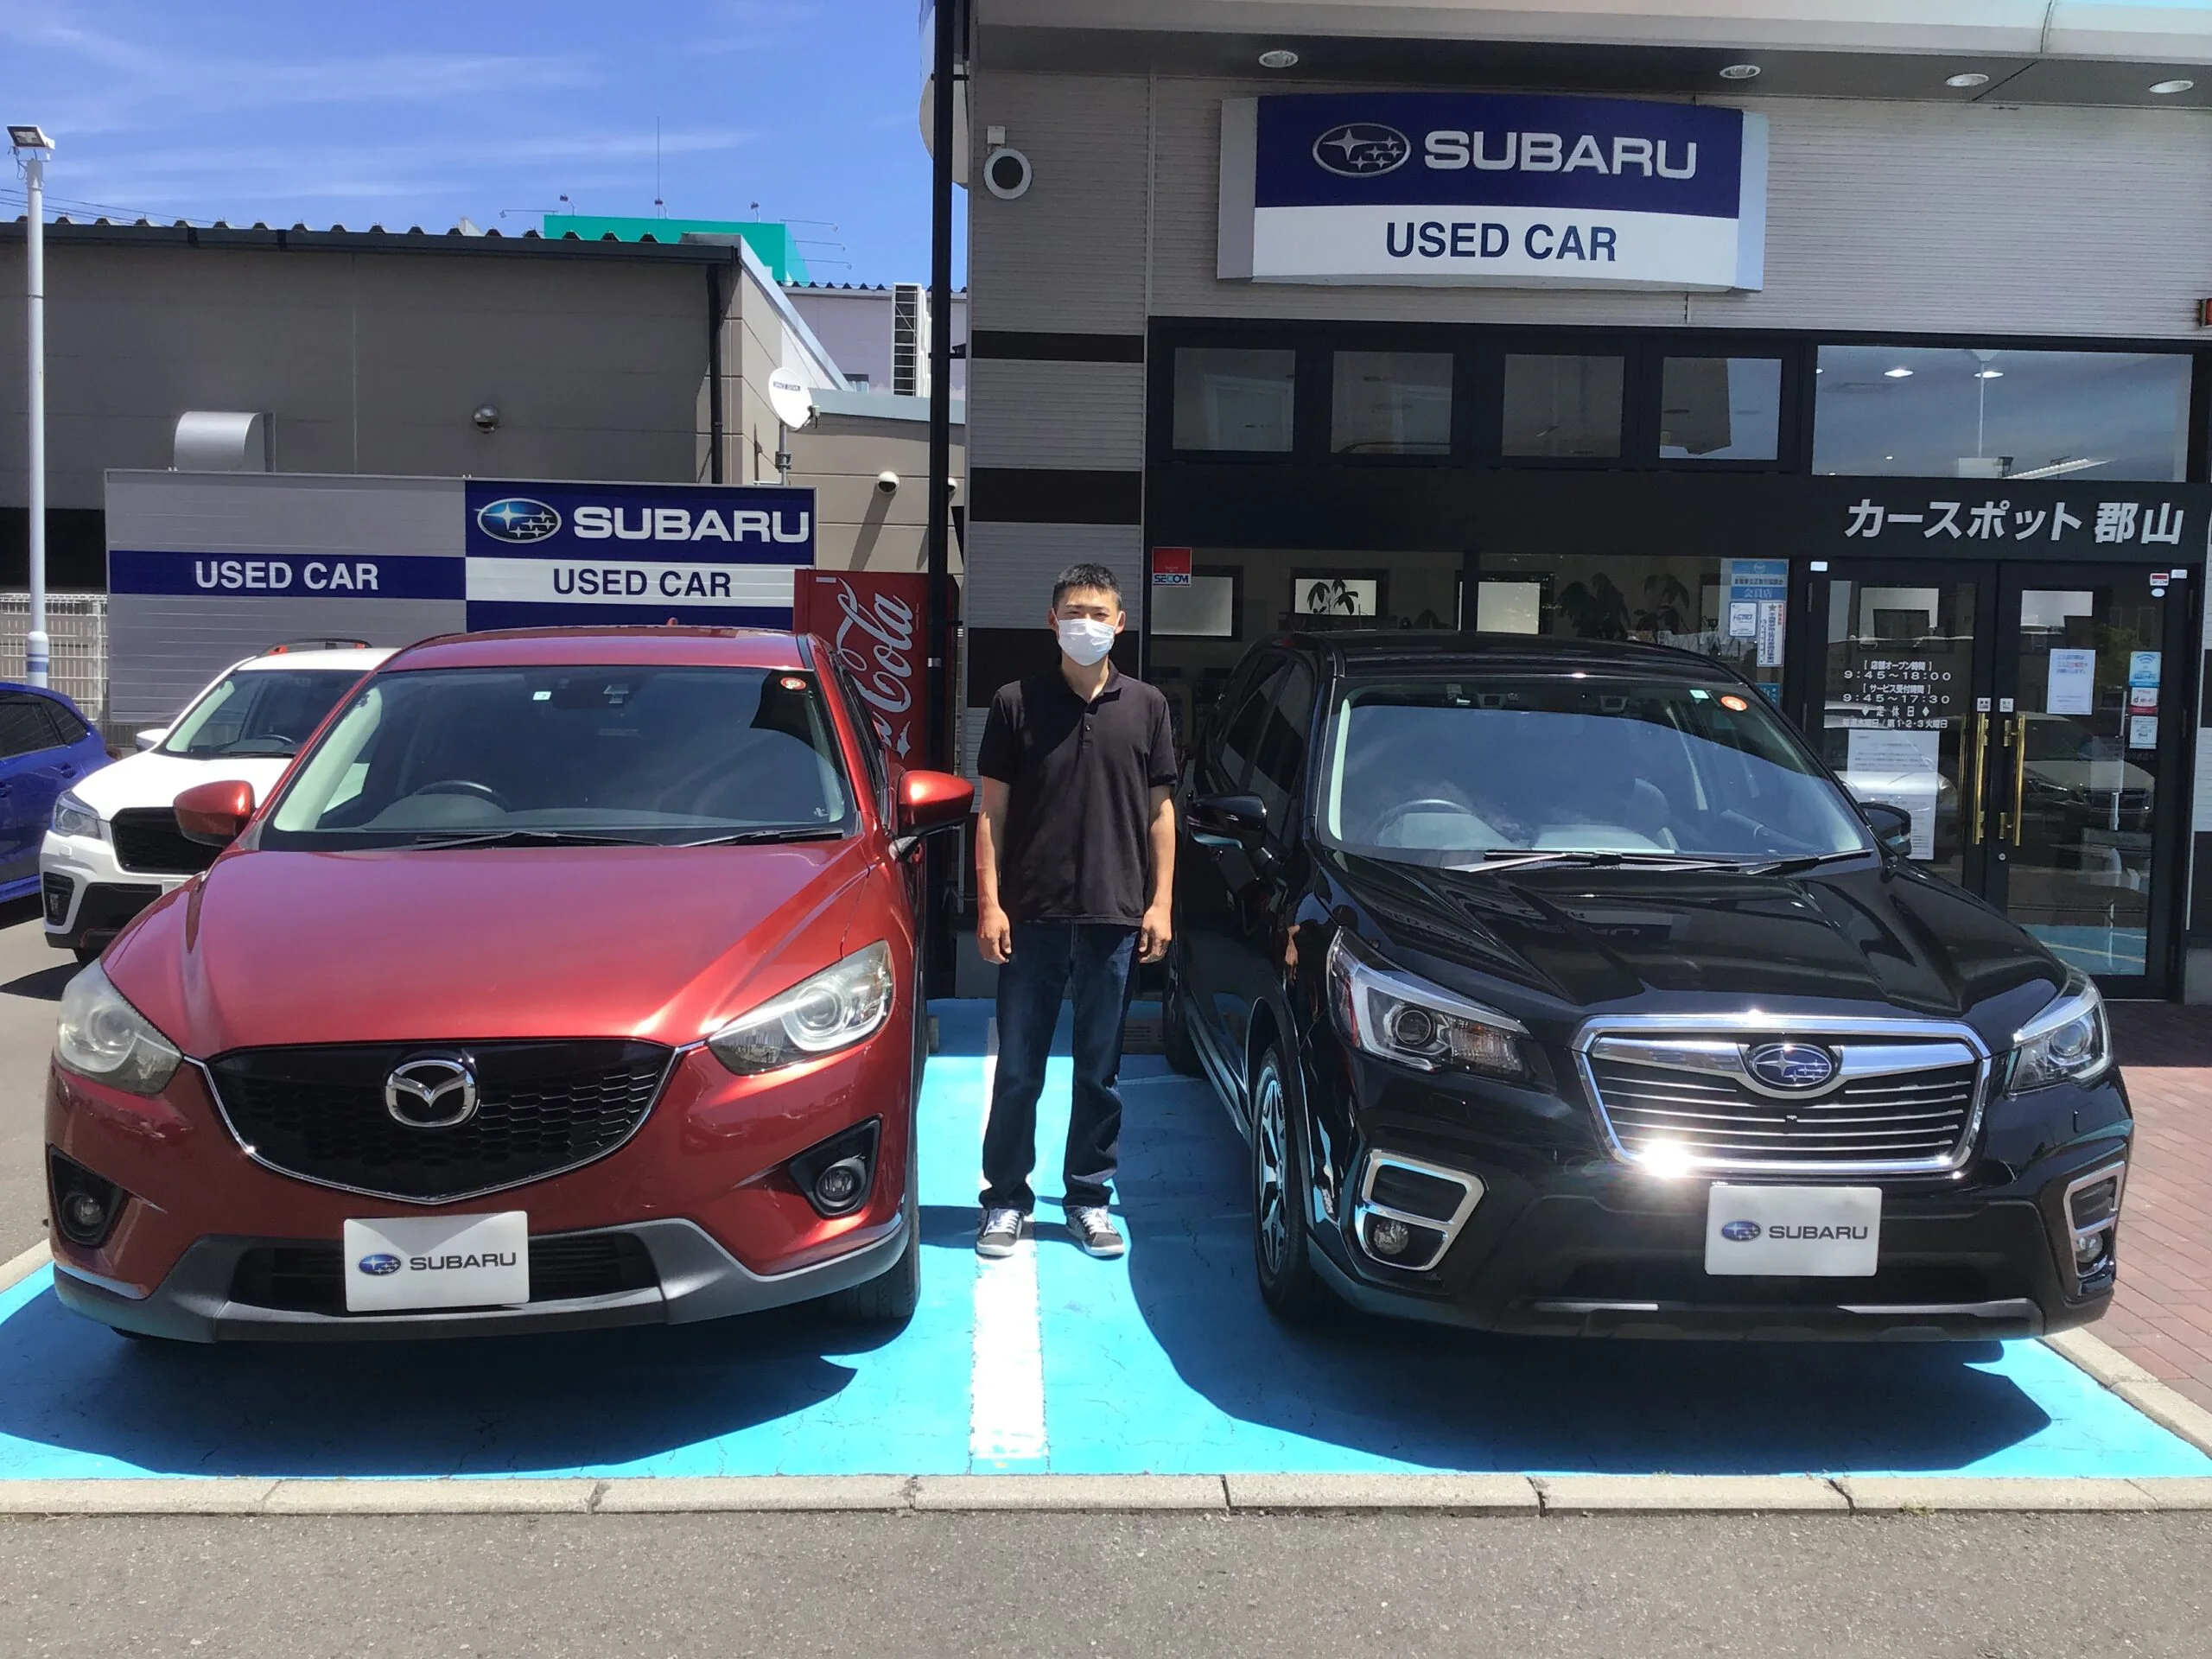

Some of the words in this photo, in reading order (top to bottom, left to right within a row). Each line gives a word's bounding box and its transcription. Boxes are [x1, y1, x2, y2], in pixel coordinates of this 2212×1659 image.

[1424, 130, 1697, 180] SUBARU
[1386, 221, 1510, 259] USED
[1524, 225, 1617, 262] CAR
[573, 506, 810, 543] SUBARU
[1845, 499, 2082, 542] カースポット
[2094, 502, 2185, 545] 郡山
[194, 561, 293, 590] USED
[303, 562, 379, 591] CAR
[552, 569, 647, 596] USED
[658, 571, 732, 598] CAR
[1154, 574, 1189, 583] SECOM
[1768, 1225, 1869, 1240] SUBARU
[410, 1252, 517, 1271] SUBARU
